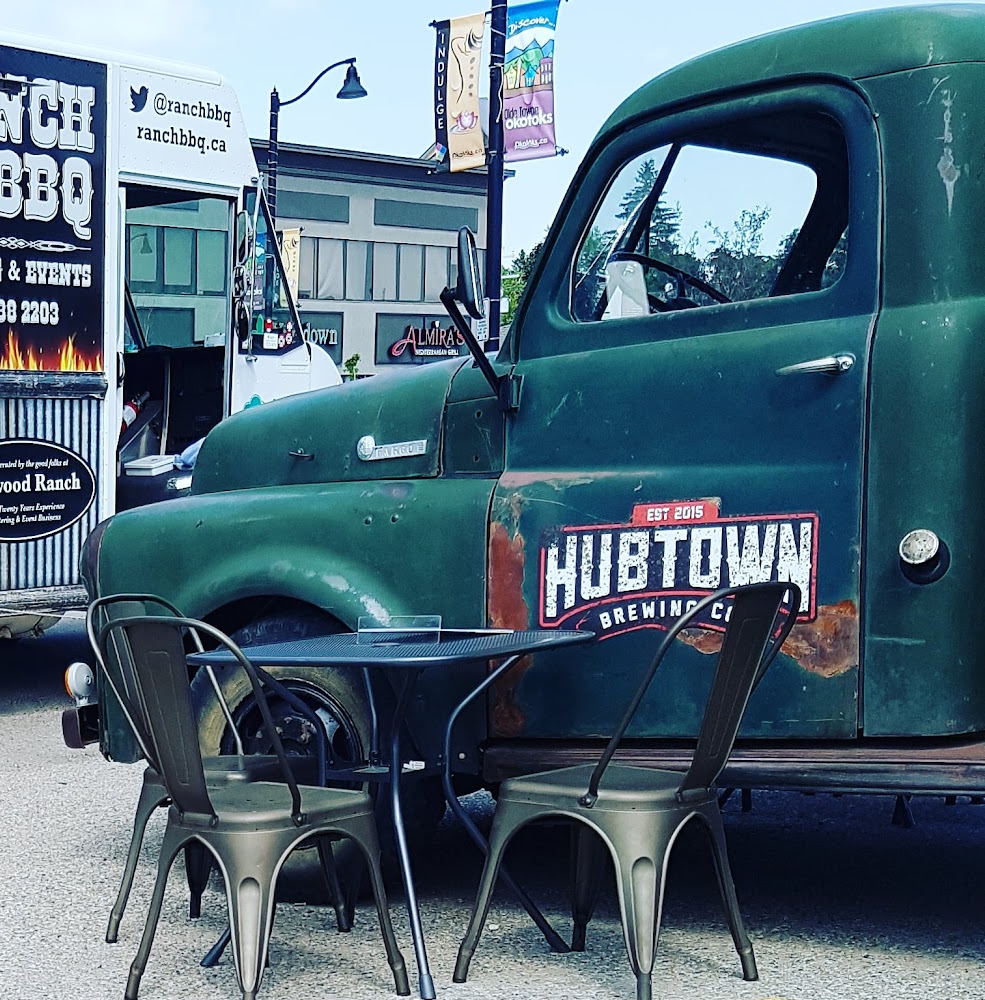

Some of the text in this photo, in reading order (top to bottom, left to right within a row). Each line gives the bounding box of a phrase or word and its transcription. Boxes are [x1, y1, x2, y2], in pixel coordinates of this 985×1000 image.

[436, 31, 447, 130] INDULGE
[153, 92, 232, 128] @ranchbbq
[136, 126, 227, 155] ranchbbq.ca
[7, 259, 21, 281] &
[25, 259, 92, 288] EVENTS
[20, 300, 60, 326] 2203
[391, 324, 465, 357] ALMIRA'S
[18, 459, 25, 470] by
[26, 459, 34, 468] the
[34, 458, 48, 470] good
[48, 458, 62, 470] folks
[34, 471, 82, 493] Ranch
[16, 514, 20, 523] &
[21, 514, 37, 523] Event
[37, 512, 62, 522] Business
[19, 503, 36, 513] Years
[35, 501, 66, 513] Experience
[646, 505, 704, 522] EST 2015
[544, 521, 814, 618] HUBTOWN
